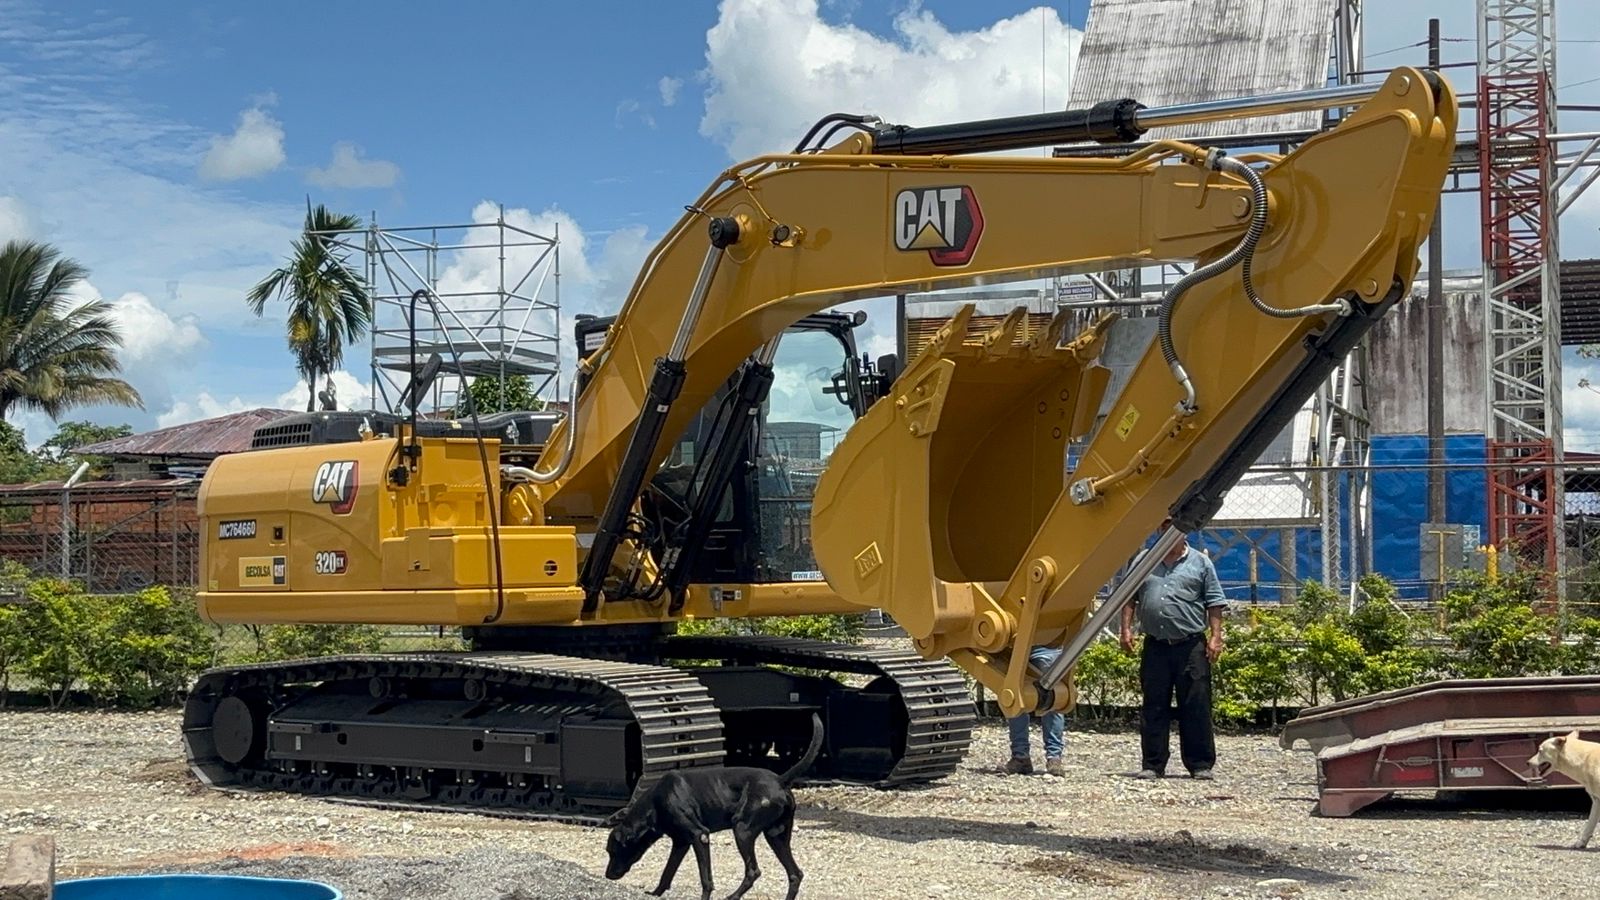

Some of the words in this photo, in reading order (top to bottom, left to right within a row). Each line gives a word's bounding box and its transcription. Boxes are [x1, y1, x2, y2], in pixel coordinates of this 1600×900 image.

[895, 187, 962, 249] CAT
[313, 461, 354, 502] CAT
[245, 565, 271, 578] GECOLSA
[315, 551, 337, 574] 320
